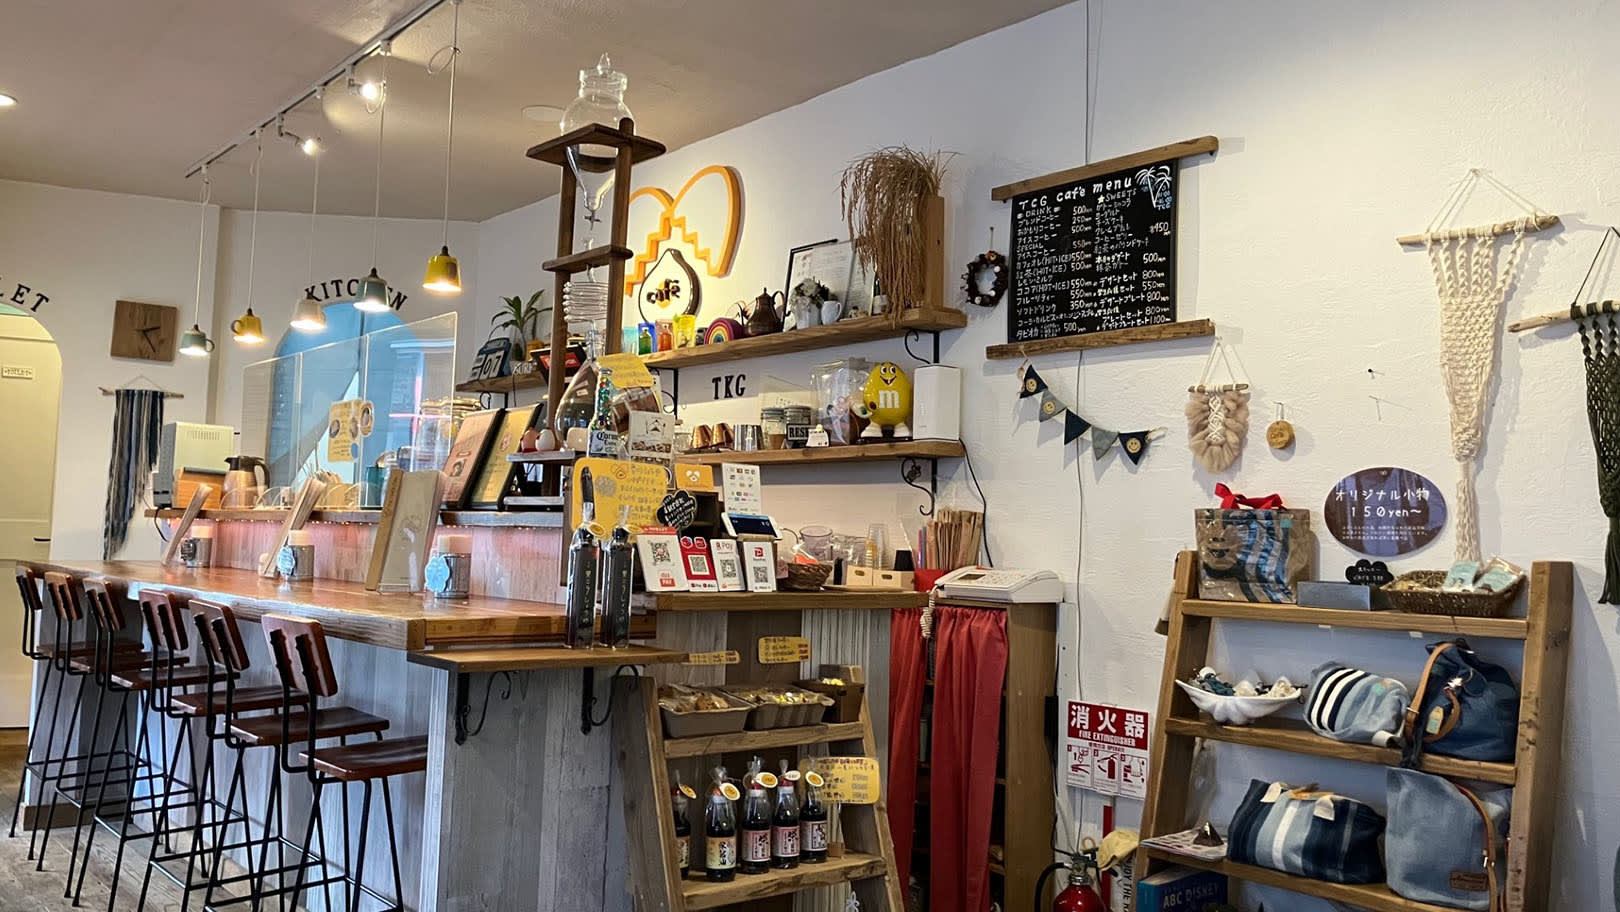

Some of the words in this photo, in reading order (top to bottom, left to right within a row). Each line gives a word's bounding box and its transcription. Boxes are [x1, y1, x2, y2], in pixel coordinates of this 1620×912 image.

[1019, 195, 1047, 210] TCG
[1093, 177, 1131, 194] menu
[304, 278, 408, 311] KITCN
[712, 374, 746, 400] TKG
[1335, 487, 1430, 501] オリジナル小物
[1070, 704, 1145, 739] 消火器
[1078, 729, 1092, 740] FIRE
[1163, 891, 1183, 909] ABC
